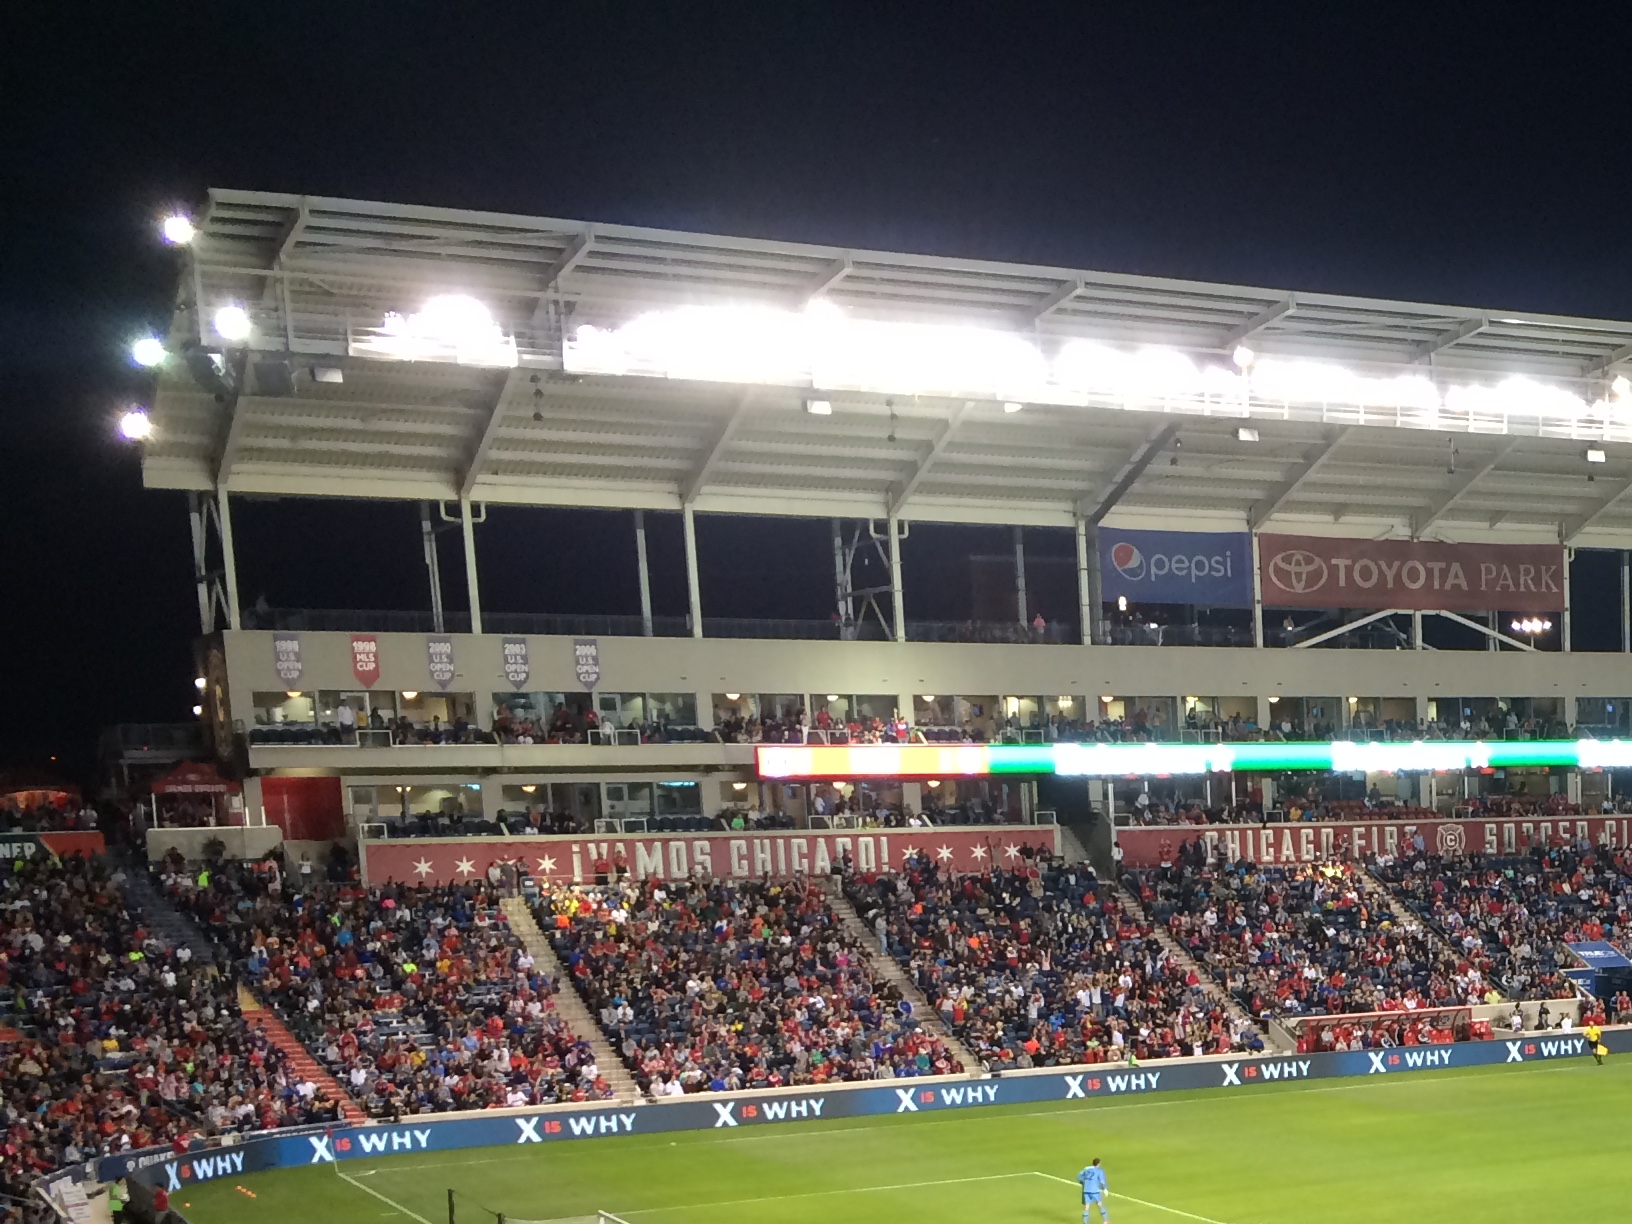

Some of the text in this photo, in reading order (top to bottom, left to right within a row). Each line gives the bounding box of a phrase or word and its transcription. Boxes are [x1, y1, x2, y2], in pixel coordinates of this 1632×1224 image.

[1151, 551, 1231, 582] pepsi
[1332, 558, 1560, 594] TOYOTA PARK
[356, 653, 375, 661] MLS
[357, 662, 376, 671] CUP
[430, 663, 454, 671] OPEN
[505, 664, 529, 672] OPEN
[576, 665, 599, 673] OPEN
[434, 672, 452, 680] CUP
[508, 673, 527, 681] CUP
[580, 674, 598, 682] CUP
[1368, 1048, 1452, 1074] X IS WHY
[1505, 1038, 1585, 1063] X IS WHY
[1064, 1071, 1160, 1099] X IS WHY
[1221, 1060, 1310, 1087] X IS WHY
[895, 1084, 998, 1113] X IS WHY
[713, 1097, 825, 1127] X IS WHY
[515, 1112, 636, 1144] X IS WHY
[309, 1129, 431, 1163] X IS WHY
[165, 1161, 182, 1193] X
[181, 1165, 190, 1178] IS
[193, 1151, 245, 1180] WHY
